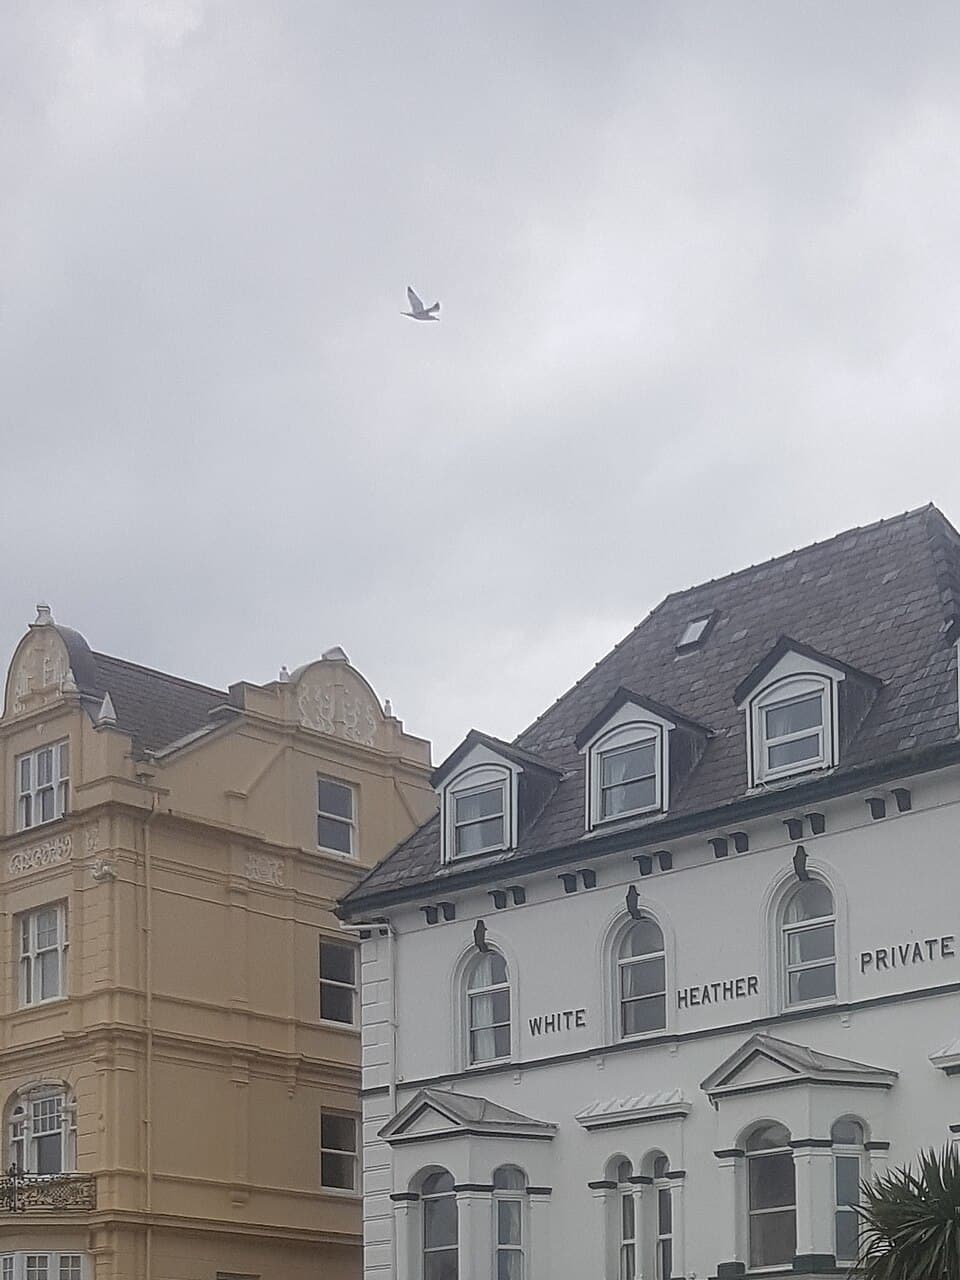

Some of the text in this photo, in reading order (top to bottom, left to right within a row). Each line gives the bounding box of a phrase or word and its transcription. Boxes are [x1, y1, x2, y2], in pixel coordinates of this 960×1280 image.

[528, 1008, 586, 1037] WHITE
[677, 975, 759, 1009] HEATHER
[860, 935, 956, 974] PRIVATE
